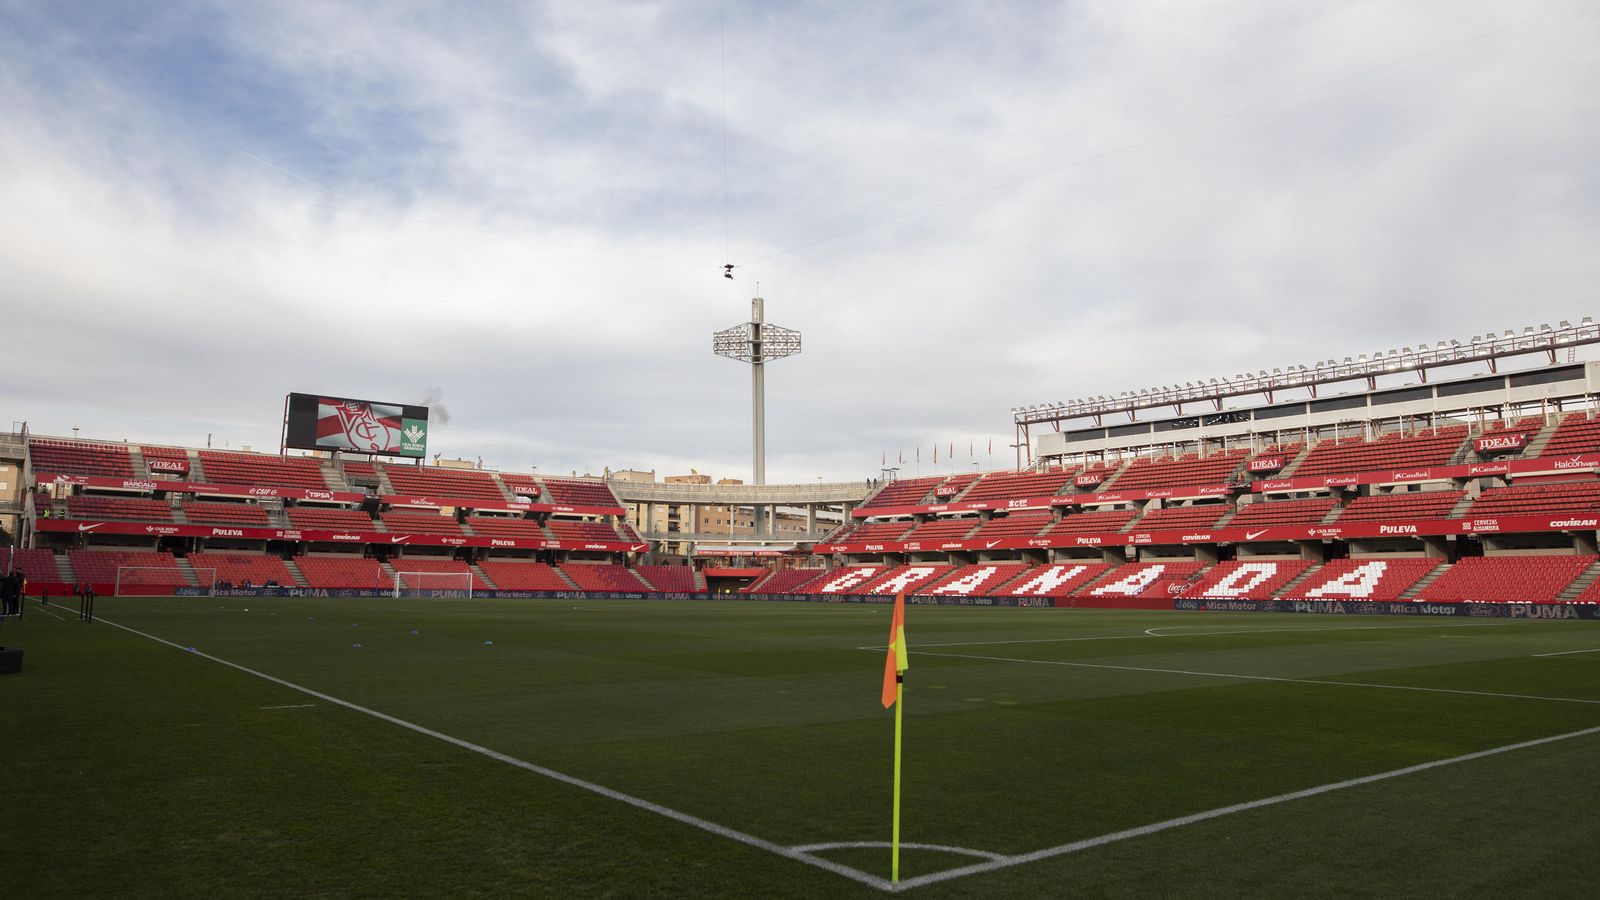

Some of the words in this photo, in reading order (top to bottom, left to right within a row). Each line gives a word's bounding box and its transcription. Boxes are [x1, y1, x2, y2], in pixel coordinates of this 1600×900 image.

[1480, 436, 1520, 448] IDEAL
[153, 461, 185, 471] IDEAL
[1251, 460, 1281, 469] IDEAL
[1478, 465, 1507, 473] CaixaBank
[1077, 475, 1100, 484] IDEAL
[309, 491, 331, 499] TIPSA
[212, 528, 243, 536] PULEVA
[1380, 525, 1417, 533] PULEVA
[290, 589, 329, 597] PUMA
[432, 590, 465, 598] PUMA
[556, 591, 587, 599] PUMA
[1018, 598, 1050, 607] PUMA
[1390, 604, 1418, 614] Mica
[1511, 605, 1580, 619] PUMA
